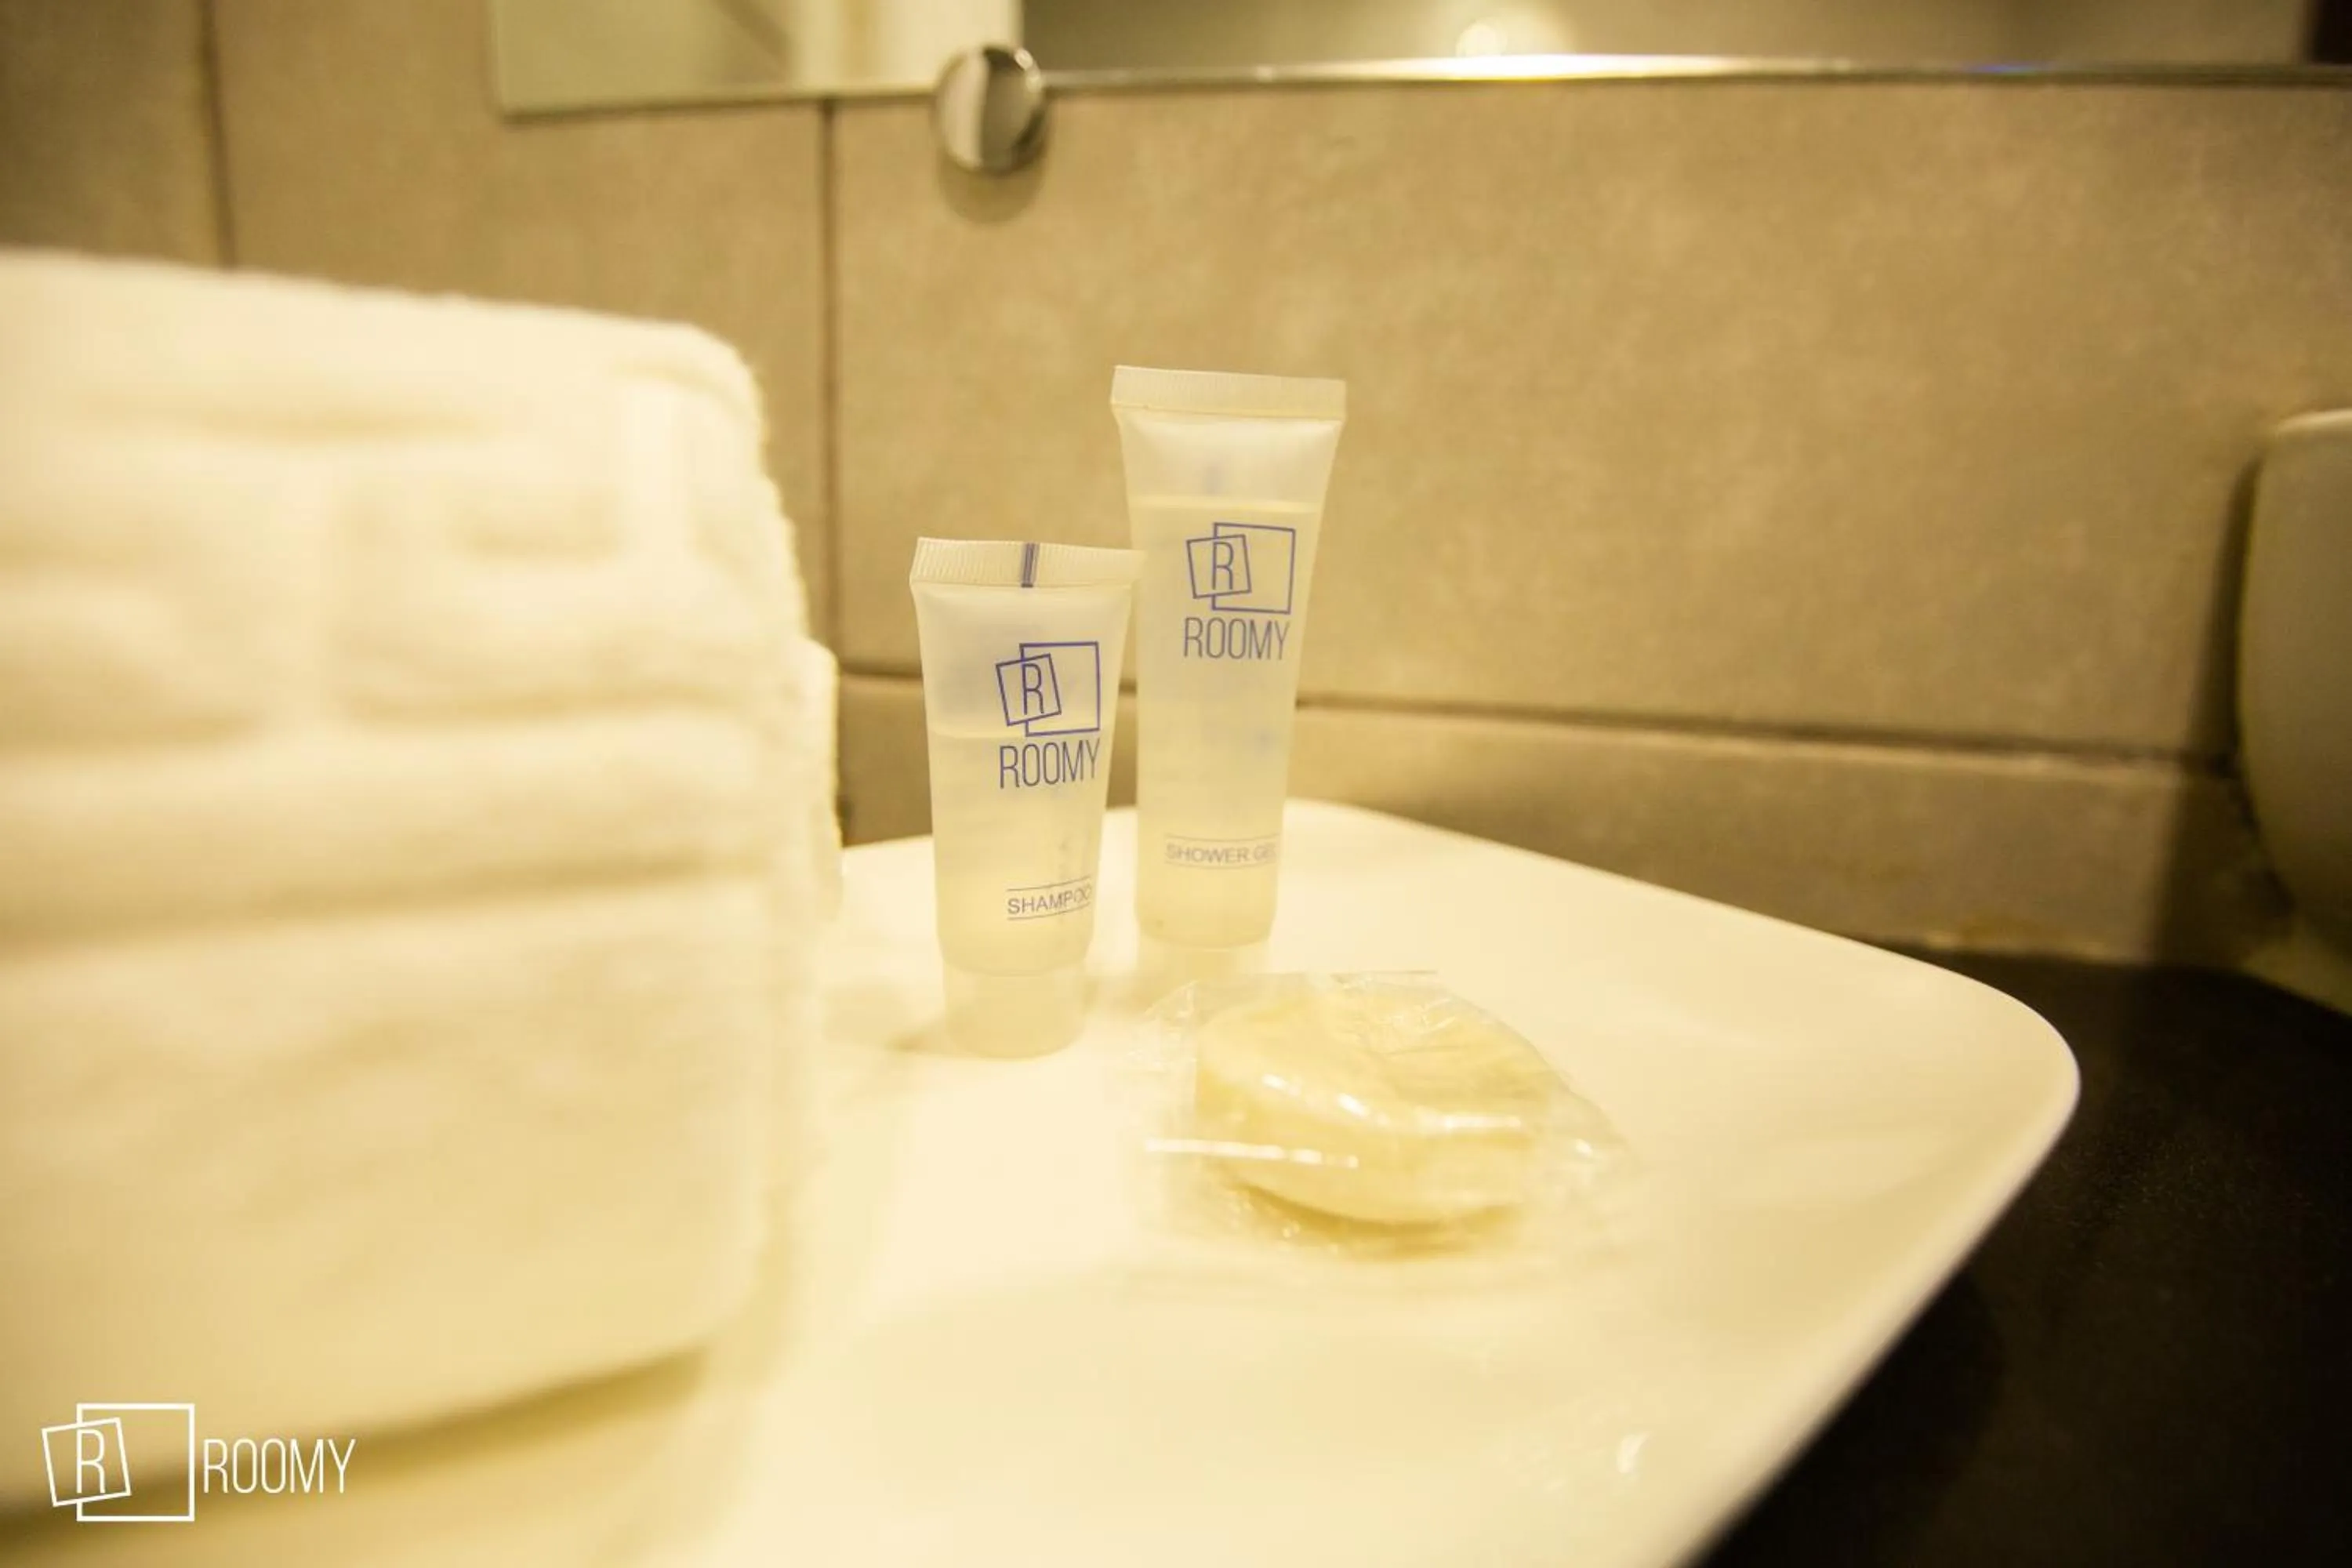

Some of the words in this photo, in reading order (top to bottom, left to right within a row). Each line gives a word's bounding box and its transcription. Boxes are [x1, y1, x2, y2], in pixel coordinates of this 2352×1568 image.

[1210, 540, 1234, 590] R
[1182, 616, 1290, 661] ROOMY
[1022, 662, 1045, 716] R
[999, 738, 1101, 789] ROOMY
[1165, 842, 1250, 863] SHOWER
